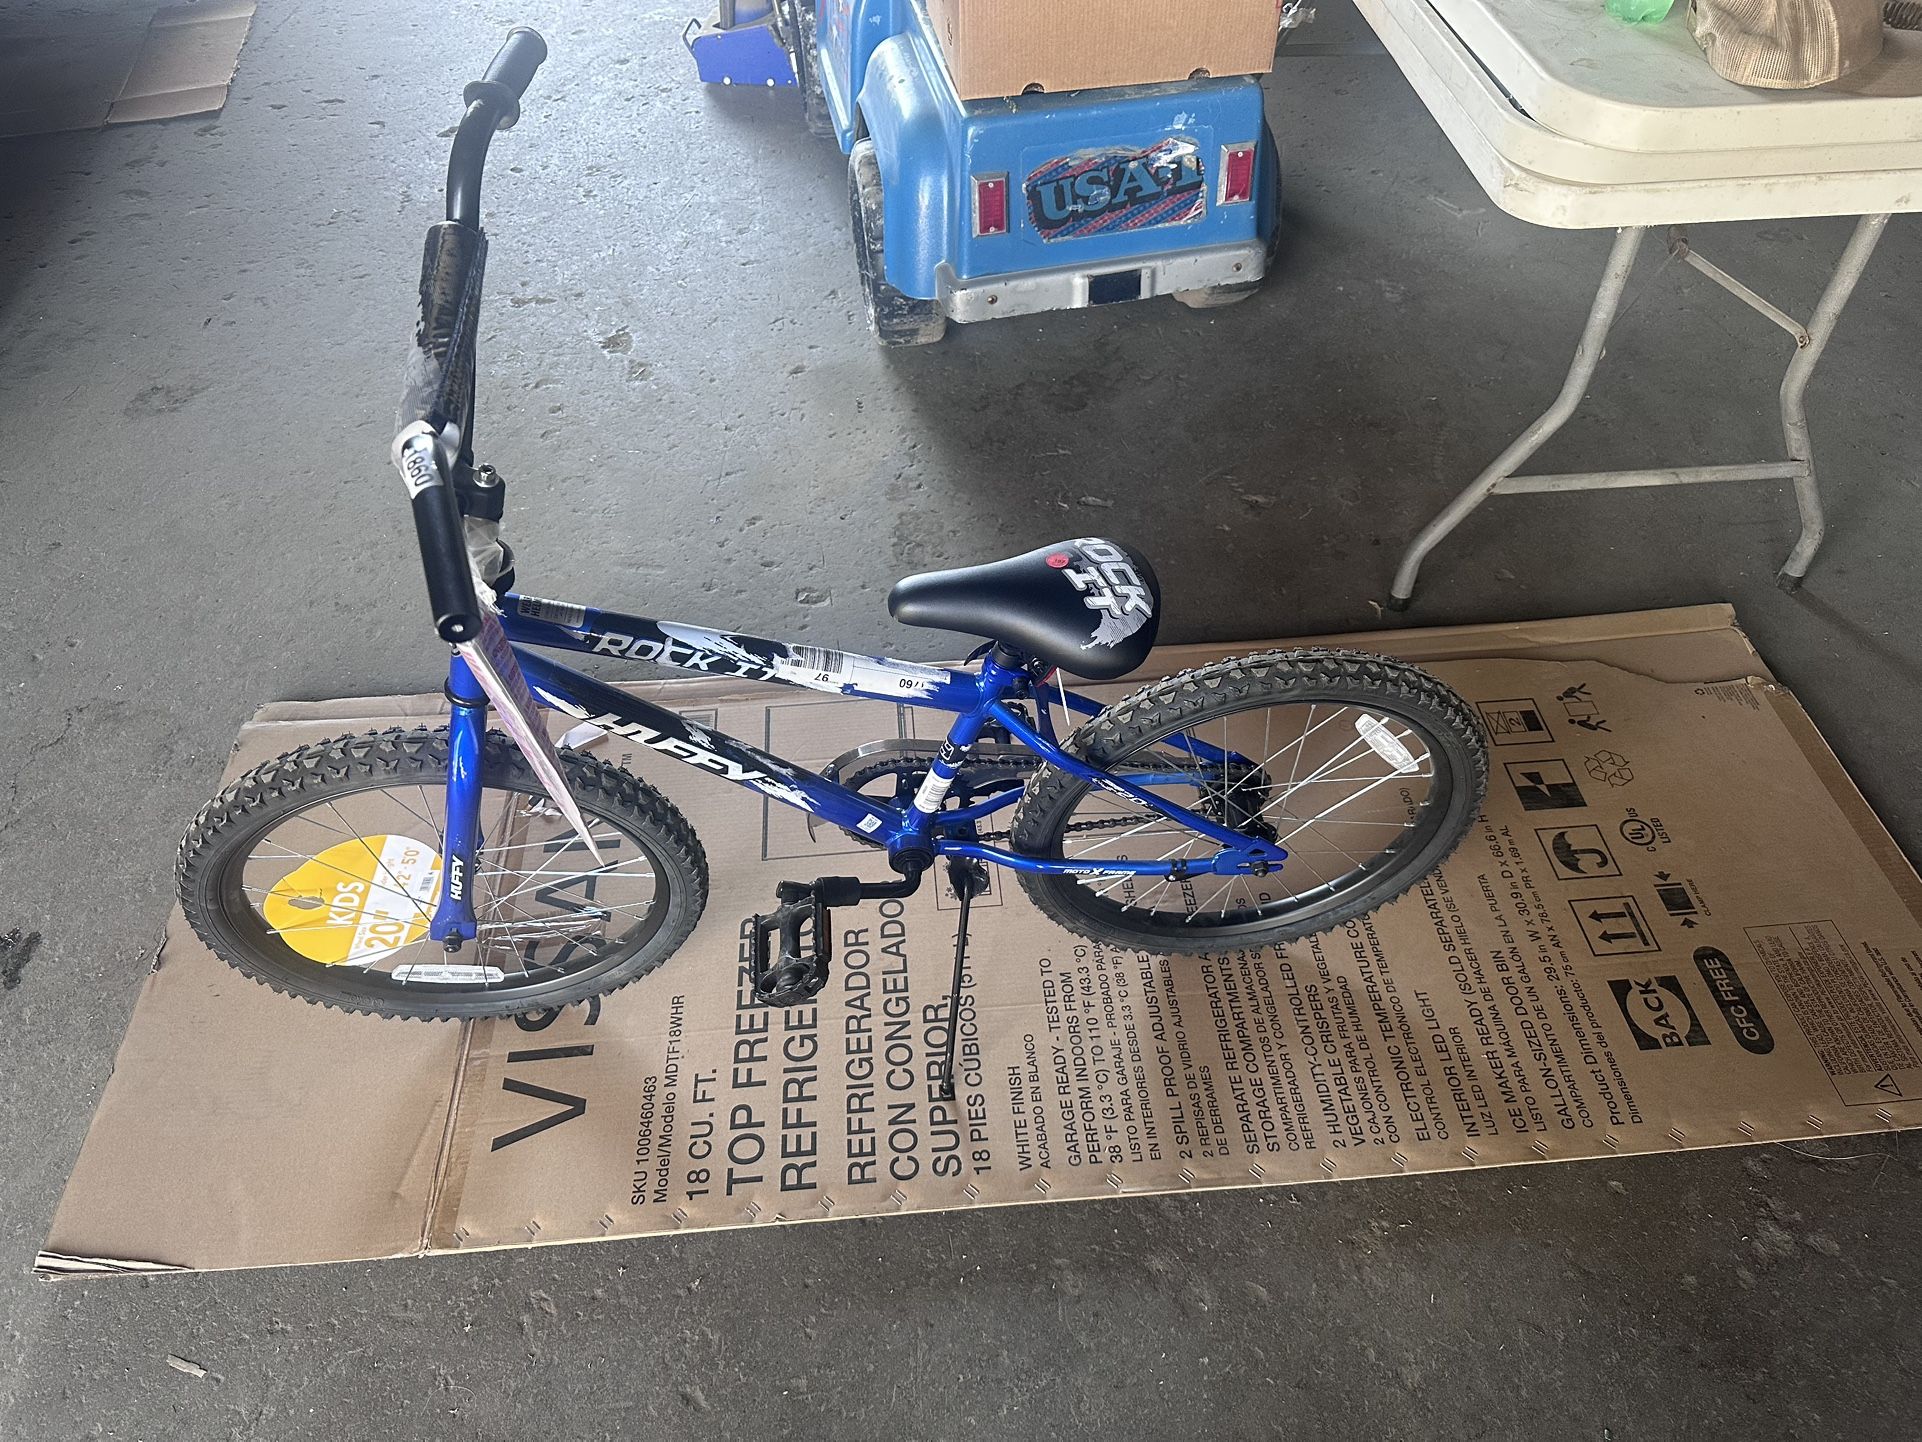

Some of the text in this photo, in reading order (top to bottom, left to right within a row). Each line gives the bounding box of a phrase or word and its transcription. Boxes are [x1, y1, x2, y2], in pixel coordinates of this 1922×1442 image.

[592, 632, 721, 673] ROCK
[1062, 567, 1122, 618] IT
[591, 712, 769, 784] HUFFY
[1506, 715, 1522, 727] 2
[451, 855, 464, 900] HUFFY
[1090, 867, 1104, 876] X
[1623, 806, 1640, 818] US
[1648, 816, 1673, 844] LISTED
[326, 880, 368, 926] KIDS
[1684, 877, 1713, 916] CLAMP HERE
[843, 927, 877, 1185] REFRIGERADOR
[877, 878, 920, 1181] CON CONGELADO
[1073, 944, 1123, 1163] 38 °F (3.3 °C) TO 110 °F (43.3 °C)
[1092, 942, 1143, 1162] LISTO PARA GARAJE PROBADO PARA
[1136, 954, 1192, 1159] 2 SPILL PROOF ADJUSTABLE
[1217, 956, 1280, 1151] STORAGE COMPARTMENTS
[1253, 961, 1316, 1149] REFRIGERADOR CONGELADOR
[1279, 962, 1346, 1147] 2 HUMIDITY-CONTROLLED
[1327, 995, 1350, 1039] FRUTAS
[1342, 1041, 1362, 1072] PARA
[1350, 941, 1431, 1141] ELECTRONIC TEMPERATURE
[1442, 896, 1547, 1131] LISTO PARA MÁQUINA DE HACER HIELO (SE
[1448, 955, 1529, 1132] ICE MAKER READY (SOLD
[1477, 873, 1593, 1127] COMPARTIMENTO DE GALÓN EN PUERTA
[1484, 834, 1625, 1125] Product Dimensions: 29.5 30.9 66.6
[1489, 950, 1575, 1129] GALLON-SIZED DOOR BIN
[1570, 979, 1643, 1123] Dimensiones producto:
[1631, 976, 1685, 1047] BACK
[1702, 957, 1762, 1040] CFC FREE
[652, 994, 684, 1203] Model/Modelo MDTF18WHR
[685, 1068, 716, 1200] 18 CU. FT.
[921, 994, 962, 1178] SUPERIOR,
[954, 993, 993, 1175] 18 PIES CÚBICOS
[1007, 1065, 1032, 1171] WHITE FINISH
[1023, 1033, 1051, 1169] ACABADO EN BLANCO
[1038, 957, 1082, 1166] GARAGE READY TESTED TO
[1059, 971, 1103, 1164] PERFORM INDOORS FROM
[1111, 955, 1161, 1160] EN INTERIORES DESDE 3.3 °C (38 °F)
[1158, 959, 1213, 1157] 2 REPISAS DE VIDRIO AJUSTABLES
[1198, 1065, 1229, 1155] DE DERRAMES
[1200, 964, 1260, 1153] SEPARATE REFRIGERATOR
[1253, 1016, 1299, 1151] COMPARTIMENTOS DE
[1304, 983, 1366, 1146] VEGETABLE CRISPERS
[1336, 975, 1400, 1143] CON CONTROL DE HUMEDAD
[1353, 1075, 1381, 1134] CAJONES
[1382, 977, 1449, 1139] CONTROL ELECTRÓNICO DE
[1413, 989, 1480, 1137] INTERIOR LED LIGHT
[1448, 1026, 1498, 1135] LUZ LED INTERIOR
[630, 1075, 657, 1204] SKU 1006460463
[723, 1100, 765, 1196] TOP
